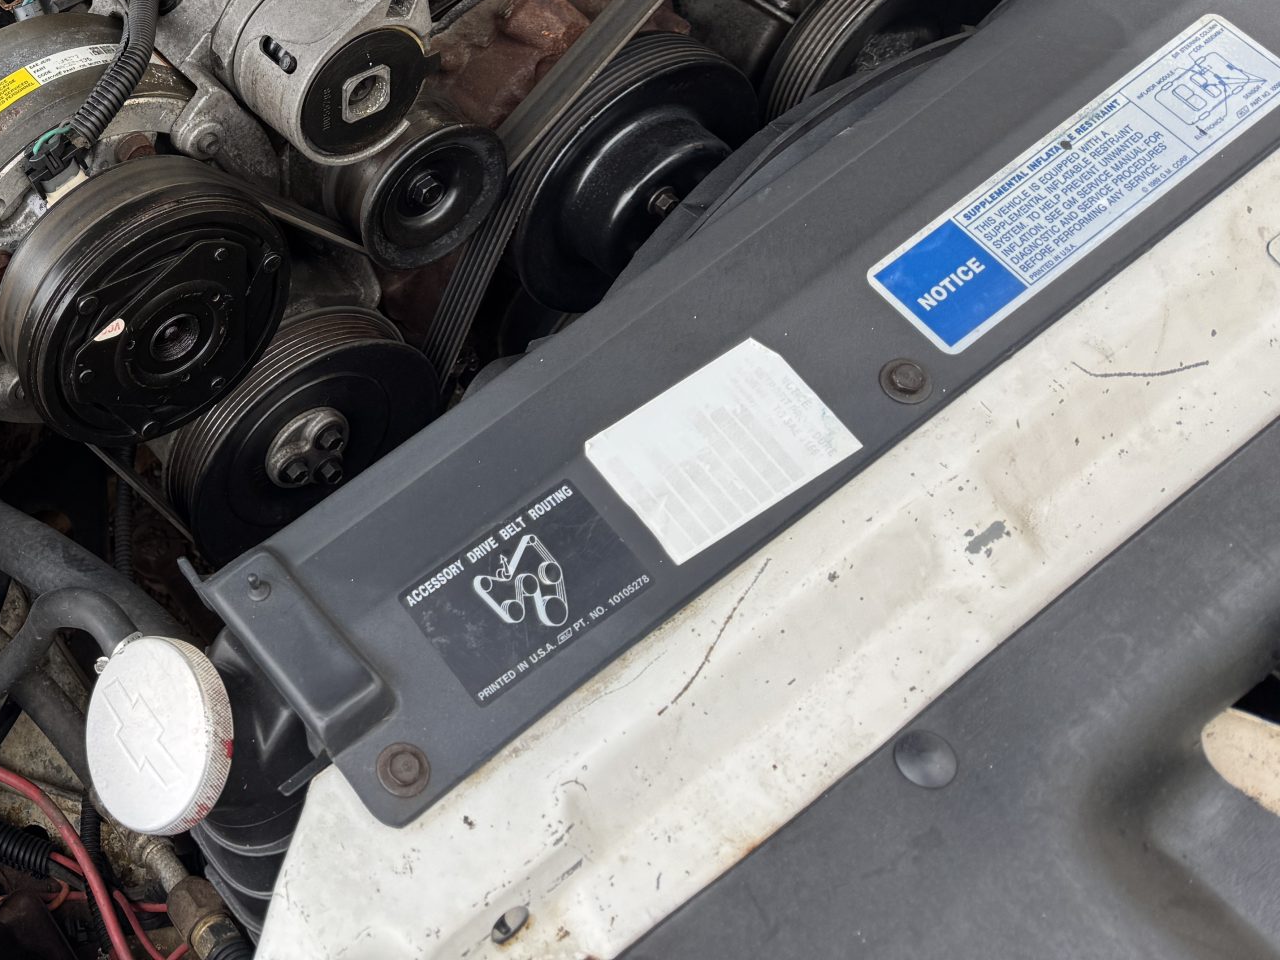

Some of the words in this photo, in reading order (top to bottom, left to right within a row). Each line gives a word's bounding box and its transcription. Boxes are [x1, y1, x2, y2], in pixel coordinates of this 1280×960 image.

[1179, 35, 1201, 53] STEERING
[1199, 21, 1219, 37] COLUMN
[1202, 26, 1225, 45] ASSEMBLY
[0, 79, 16, 90] CAUSE
[4, 80, 29, 97] SERVICED
[5, 82, 35, 101] PERSONNEL
[1155, 69, 1175, 85] MODULE
[1242, 84, 1262, 100] SENSOR
[1249, 96, 1263, 107] PART
[962, 169, 1029, 221] SUPPLEMENTAL
[1073, 98, 1121, 135] RESTRAINT
[974, 215, 997, 234] THIS
[994, 189, 1031, 218] VEHICLE
[1028, 181, 1041, 192] IS
[1038, 150, 1081, 184] EQUIPPED
[1079, 135, 1101, 153] WITH
[1099, 128, 1110, 137] A
[1171, 154, 1190, 169] CORP.
[982, 191, 1046, 241] SUPPLEMENTAL
[1043, 156, 1092, 194] INFLATABLE
[1089, 124, 1134, 159] RESTRAINT
[991, 219, 1029, 249] SYSTEM.
[1026, 210, 1041, 222] TO
[1042, 193, 1063, 210] HELP
[1060, 164, 1100, 196] PREVENT
[1098, 130, 1145, 167] UNWANTED
[1000, 220, 1048, 257] INFLATION,
[1044, 207, 1064, 223] SEE
[1061, 195, 1079, 210] GM
[1075, 168, 1113, 198] SERVICE
[1110, 143, 1147, 172] MANUAL
[1143, 129, 1164, 146] FOR
[1009, 224, 1061, 265] DIAGNOSTIC
[1058, 209, 1080, 227] AND
[1076, 183, 1114, 213] SERVICE
[1111, 141, 1168, 186] PROCEDURES
[1018, 243, 1055, 273] BEFORE
[1052, 202, 1108, 246] PERFORMING
[1105, 188, 1126, 205] ANY
[1123, 160, 1162, 191] SERVICE.
[915, 256, 986, 311] NOTICE
[1027, 259, 1055, 281] PRINTED
[1052, 254, 1061, 262] IN
[406, 559, 465, 607] ACCESSORY
[466, 536, 499, 565] DRIVE
[499, 516, 527, 542] BELT
[527, 484, 574, 521] ROUTING
[477, 669, 516, 702] PRINTED
[517, 660, 529, 673] IN
[529, 641, 557, 663] U.S.A.
[572, 615, 589, 632] PT.
[589, 604, 608, 620] NO.
[608, 573, 651, 606] 10105278
